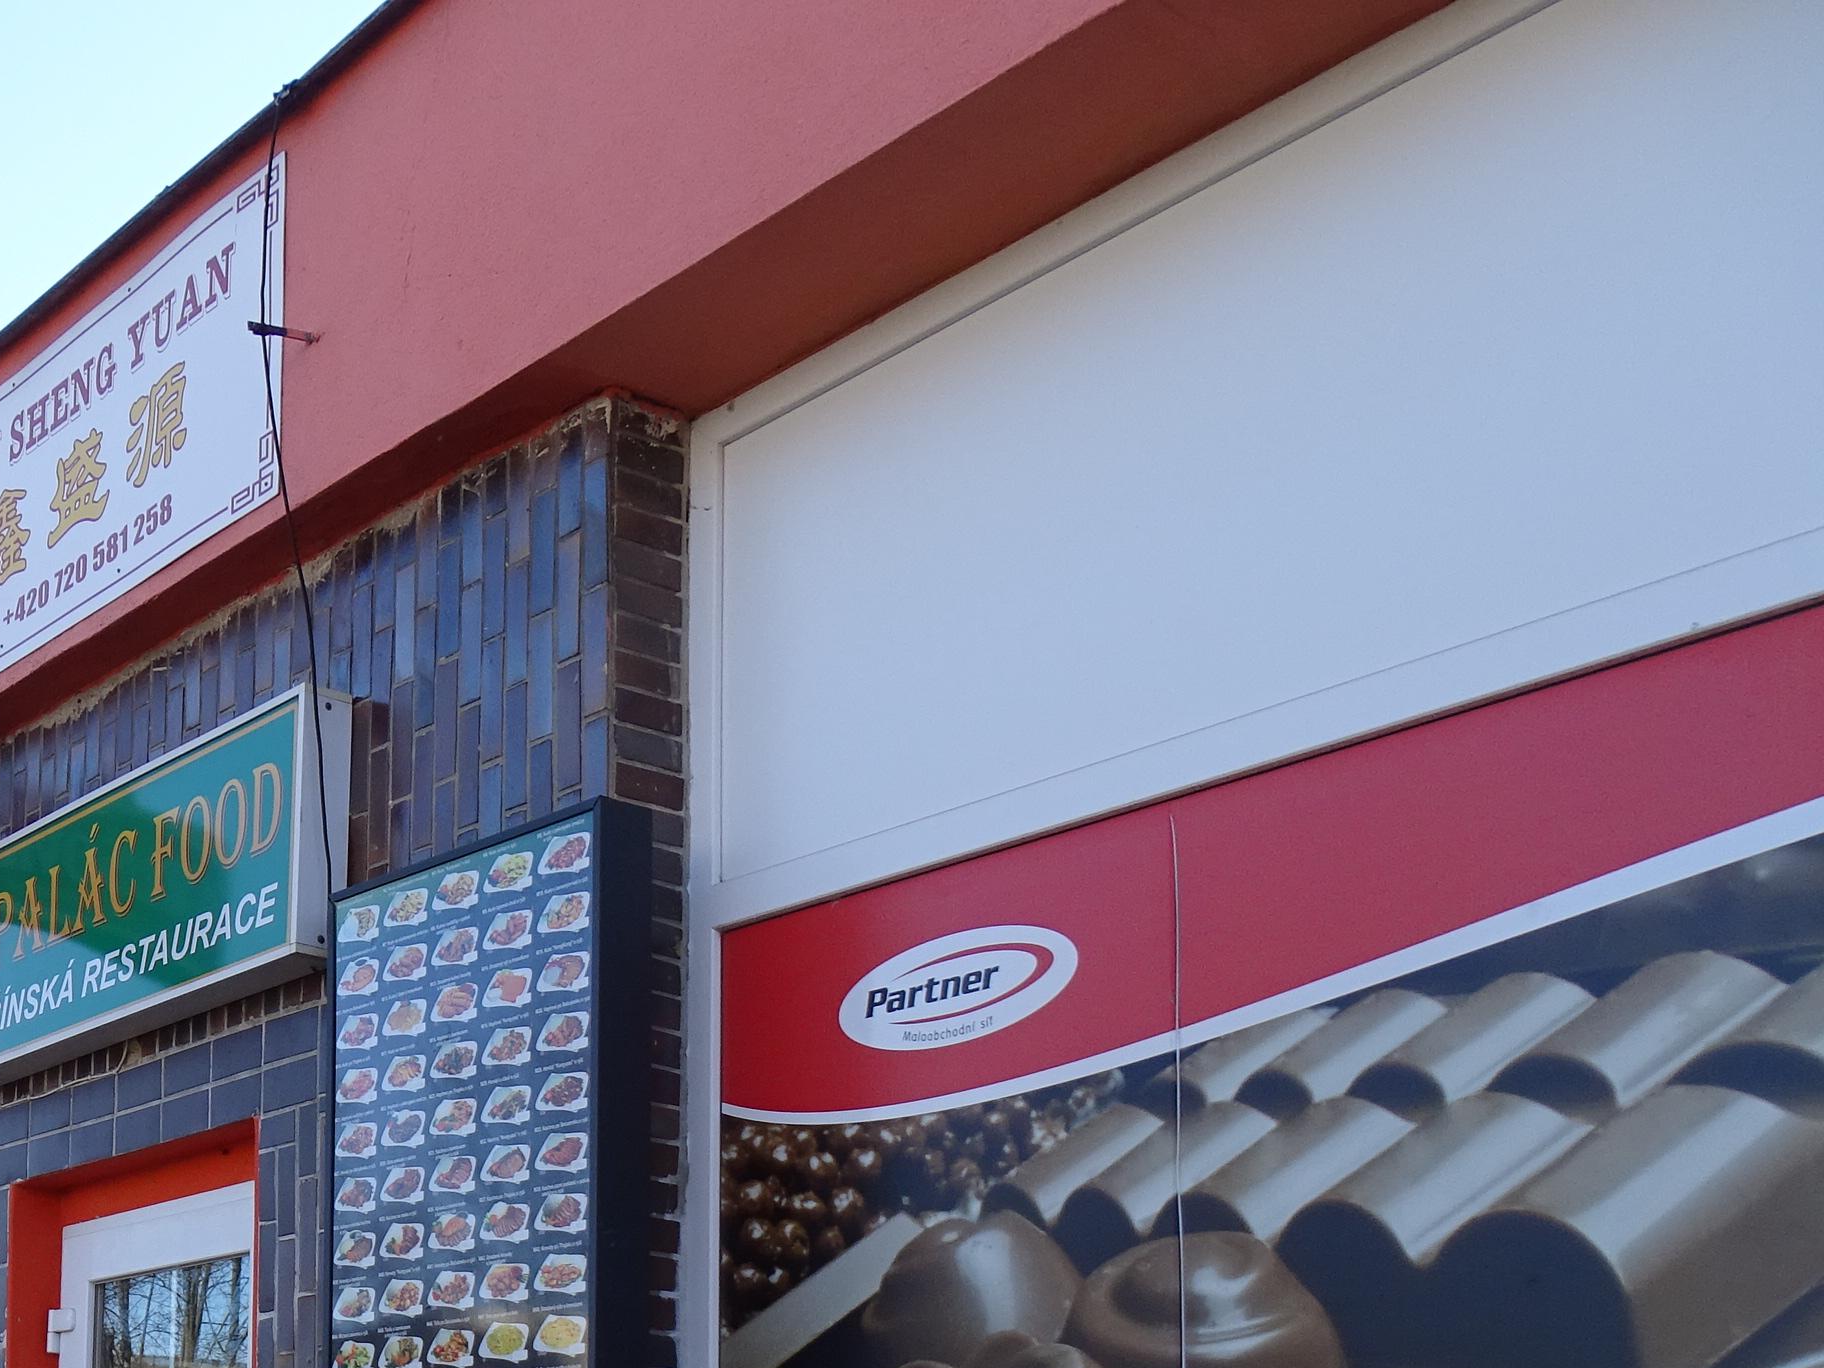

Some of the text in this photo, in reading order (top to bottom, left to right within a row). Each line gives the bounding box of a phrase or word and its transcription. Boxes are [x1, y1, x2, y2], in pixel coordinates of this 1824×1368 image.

[9, 343, 116, 462] SHENG
[127, 242, 235, 370] YUAN
[3, 579, 50, 625] +420
[54, 553, 87, 599] 720
[92, 524, 128, 572] 581
[133, 494, 172, 546] 258
[149, 762, 284, 902] FOOD
[81, 882, 279, 999] RESTAURACE
[865, 965, 1001, 1019] Partner
[902, 1021, 975, 1042] Maloobchodní
